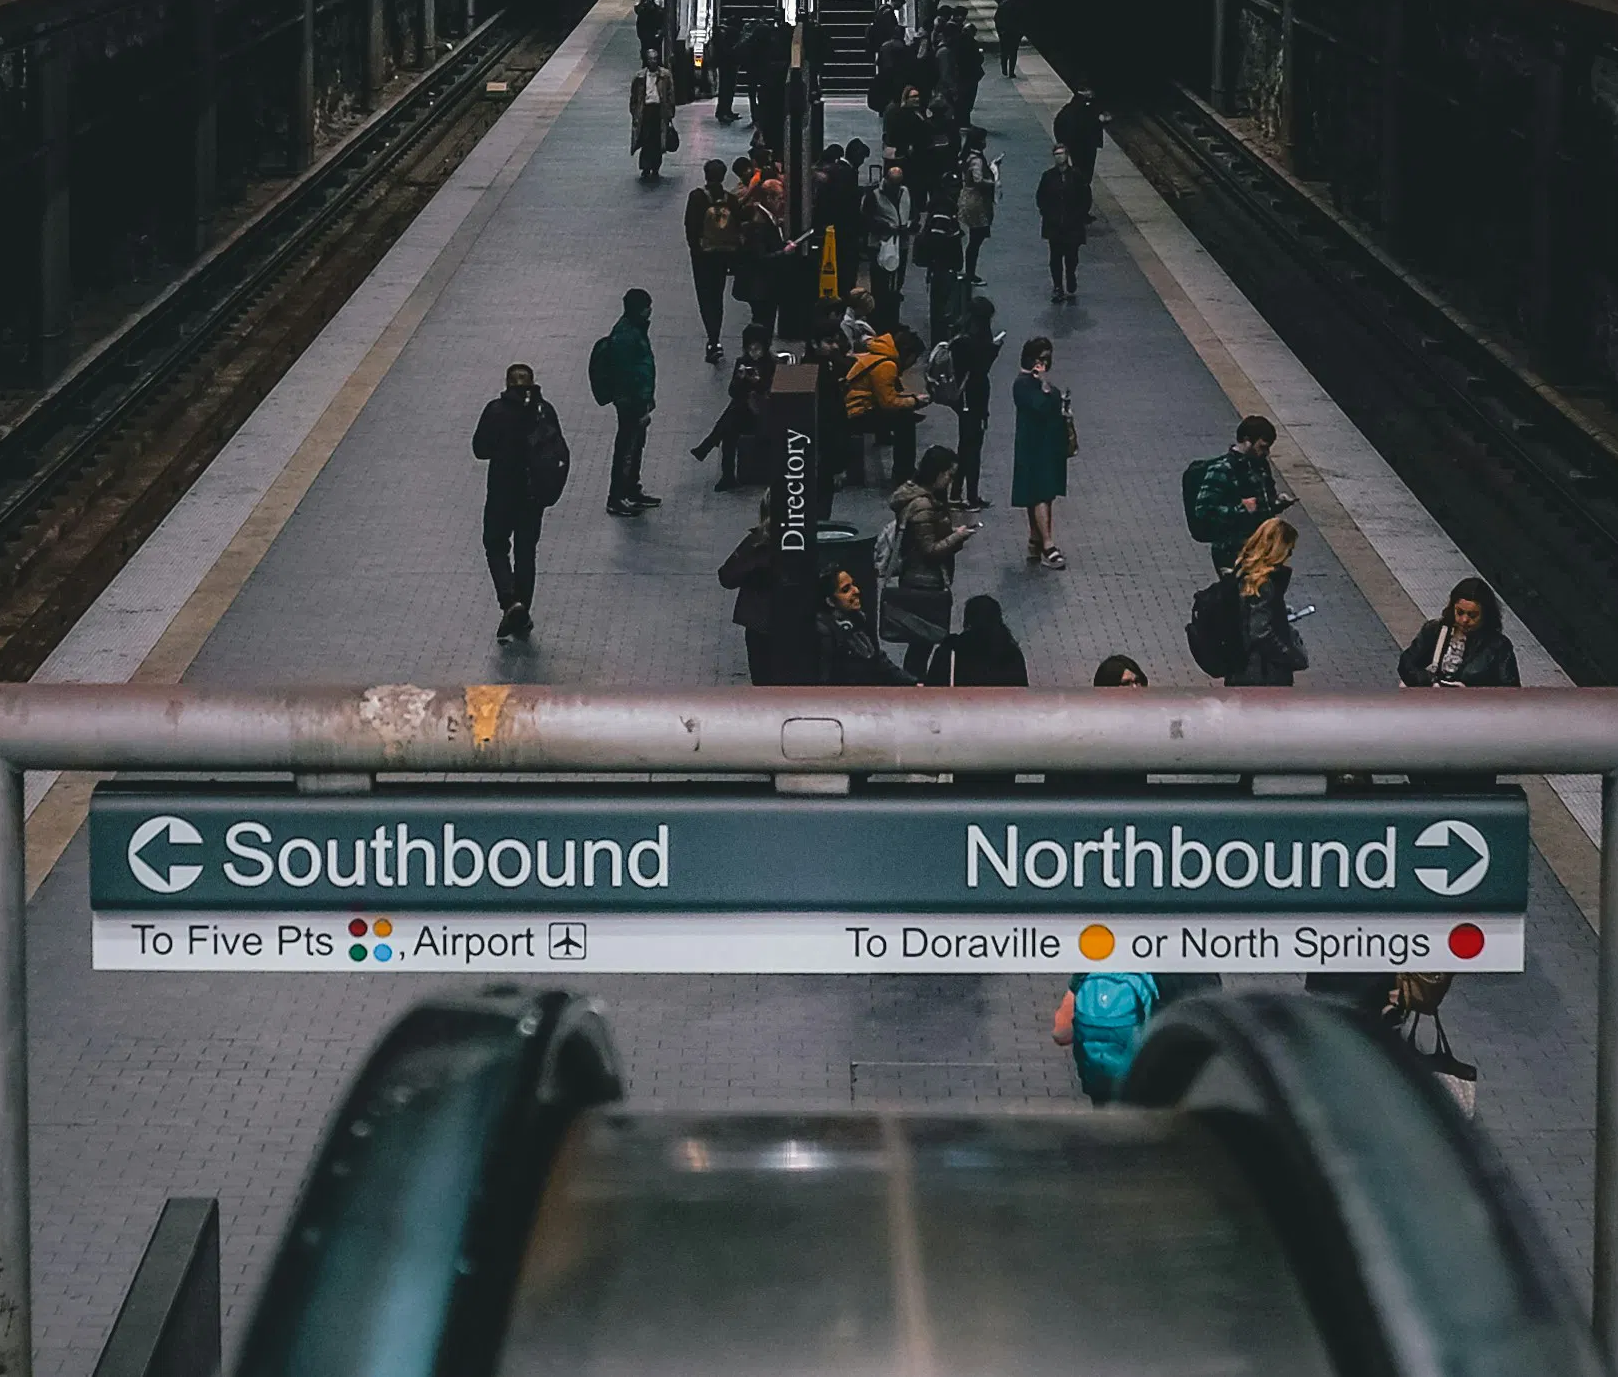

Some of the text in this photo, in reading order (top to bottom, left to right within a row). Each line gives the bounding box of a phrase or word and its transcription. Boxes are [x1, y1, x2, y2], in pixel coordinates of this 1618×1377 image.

[781, 429, 811, 551] Directory
[223, 821, 1396, 888] Southbound Northbound
[131, 925, 173, 956] To
[188, 924, 263, 956] Five
[278, 925, 334, 956] Pts
[413, 925, 535, 964] Airport
[846, 926, 1430, 965] To Doraville or North Springs
